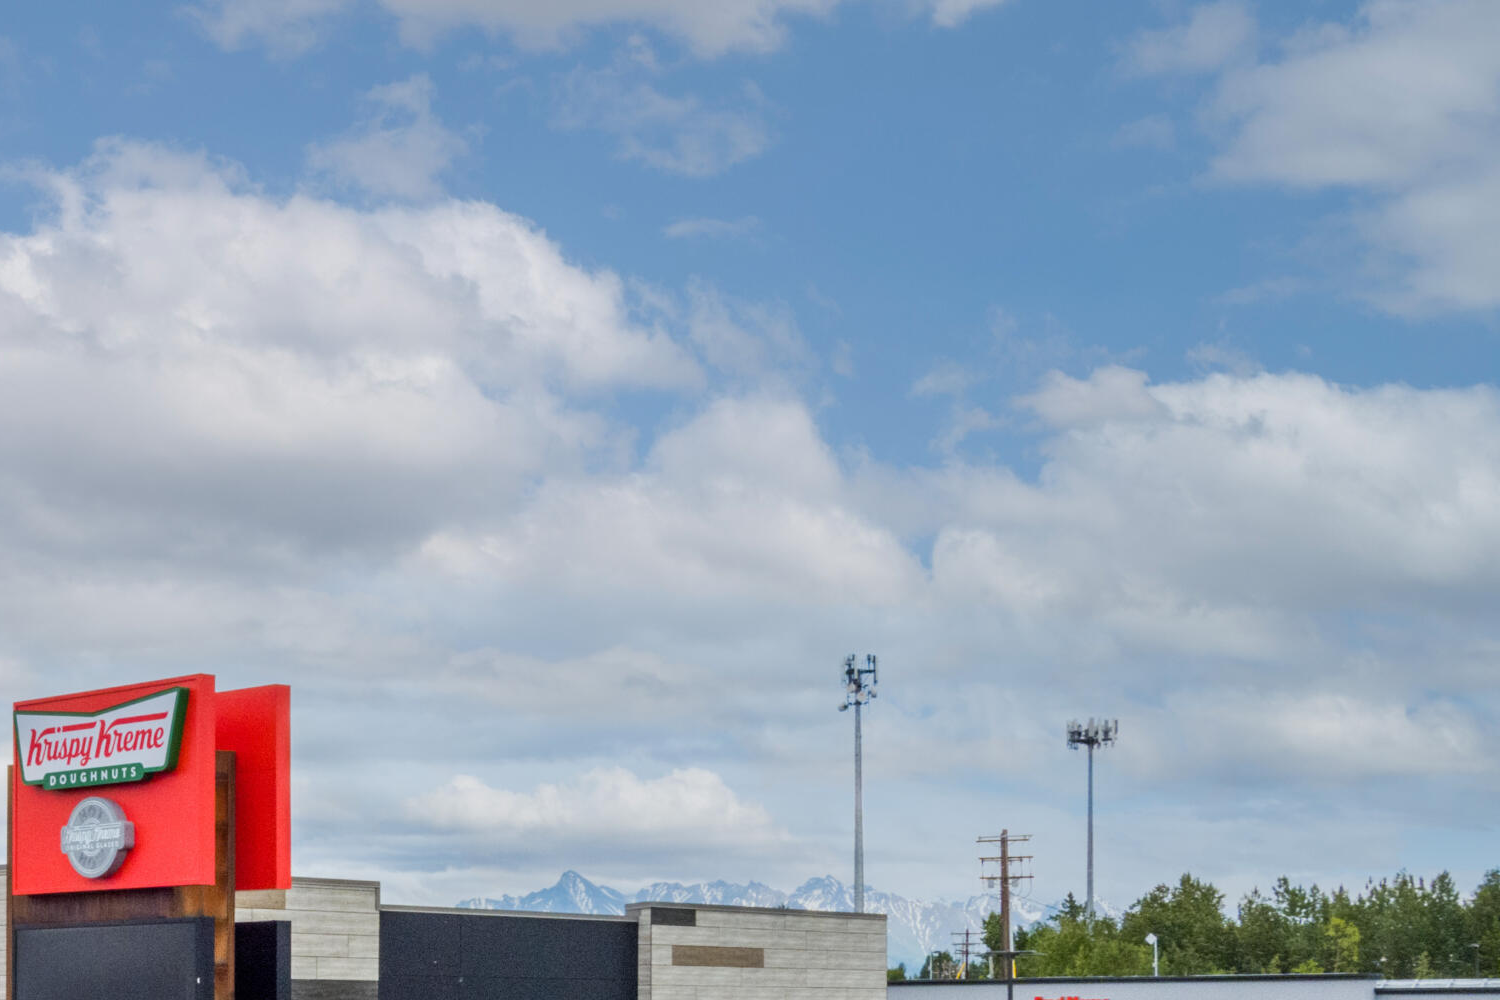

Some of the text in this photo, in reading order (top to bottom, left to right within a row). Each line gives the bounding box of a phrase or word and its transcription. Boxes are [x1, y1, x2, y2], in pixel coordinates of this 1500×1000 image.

[27, 711, 169, 767] Krispy Kreme
[49, 765, 137, 787] DOUGHNUTS
